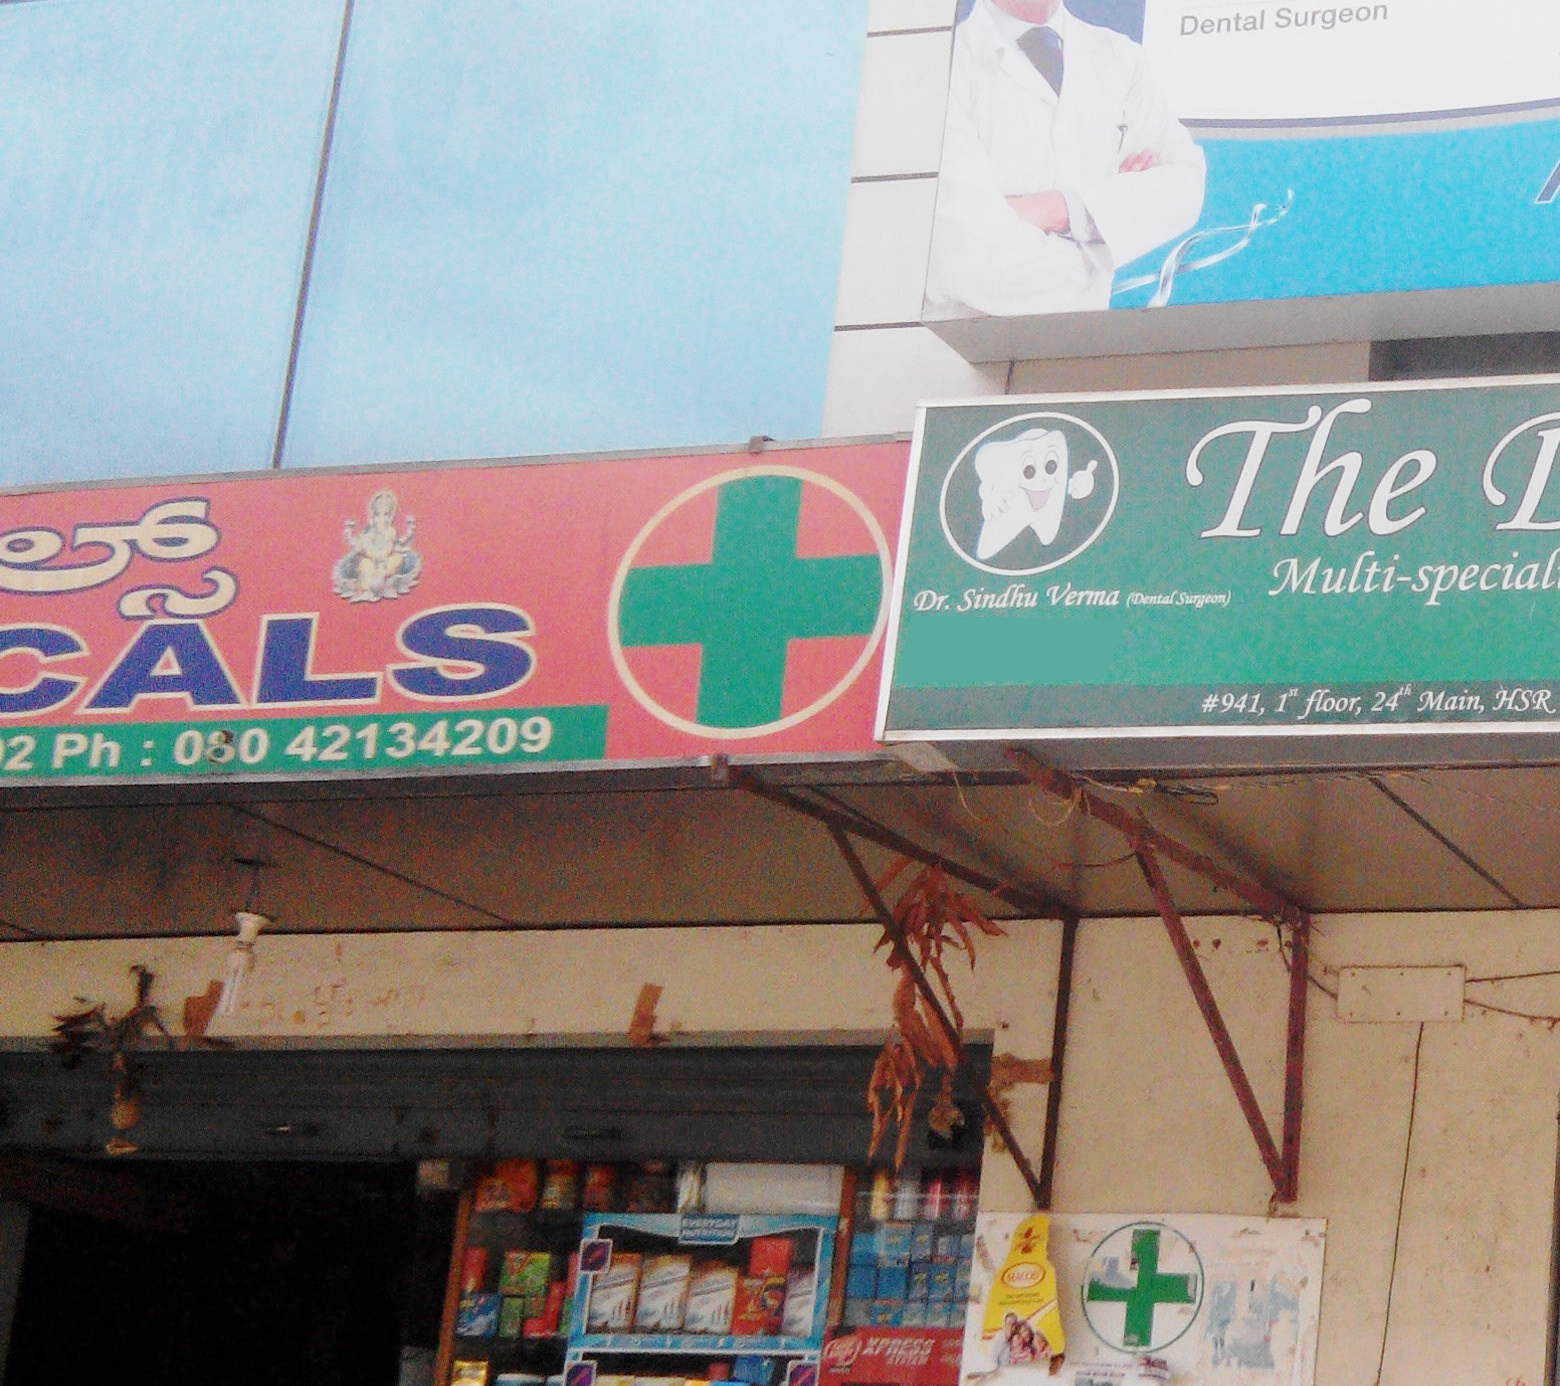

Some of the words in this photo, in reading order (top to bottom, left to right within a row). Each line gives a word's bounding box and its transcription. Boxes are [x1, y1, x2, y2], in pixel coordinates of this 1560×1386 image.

[1179, 10, 1265, 36] Dental
[1274, 4, 1389, 31] Surgeon
[1185, 398, 1438, 539] The
[913, 588, 950, 612] Dr.
[956, 582, 1038, 612] Sindhu
[1046, 581, 1120, 608] Verma
[1126, 590, 1176, 608] (Dental
[1178, 589, 1232, 608] Surgeon)
[1202, 691, 1266, 717] #941,
[1298, 689, 1362, 719] floor,
[1417, 688, 1486, 714] Main,
[1492, 687, 1556, 714] HSR
[0, 734, 36, 771] 2
[52, 732, 122, 768] Ph
[174, 728, 270, 765] 080
[286, 716, 553, 759] 42134209
